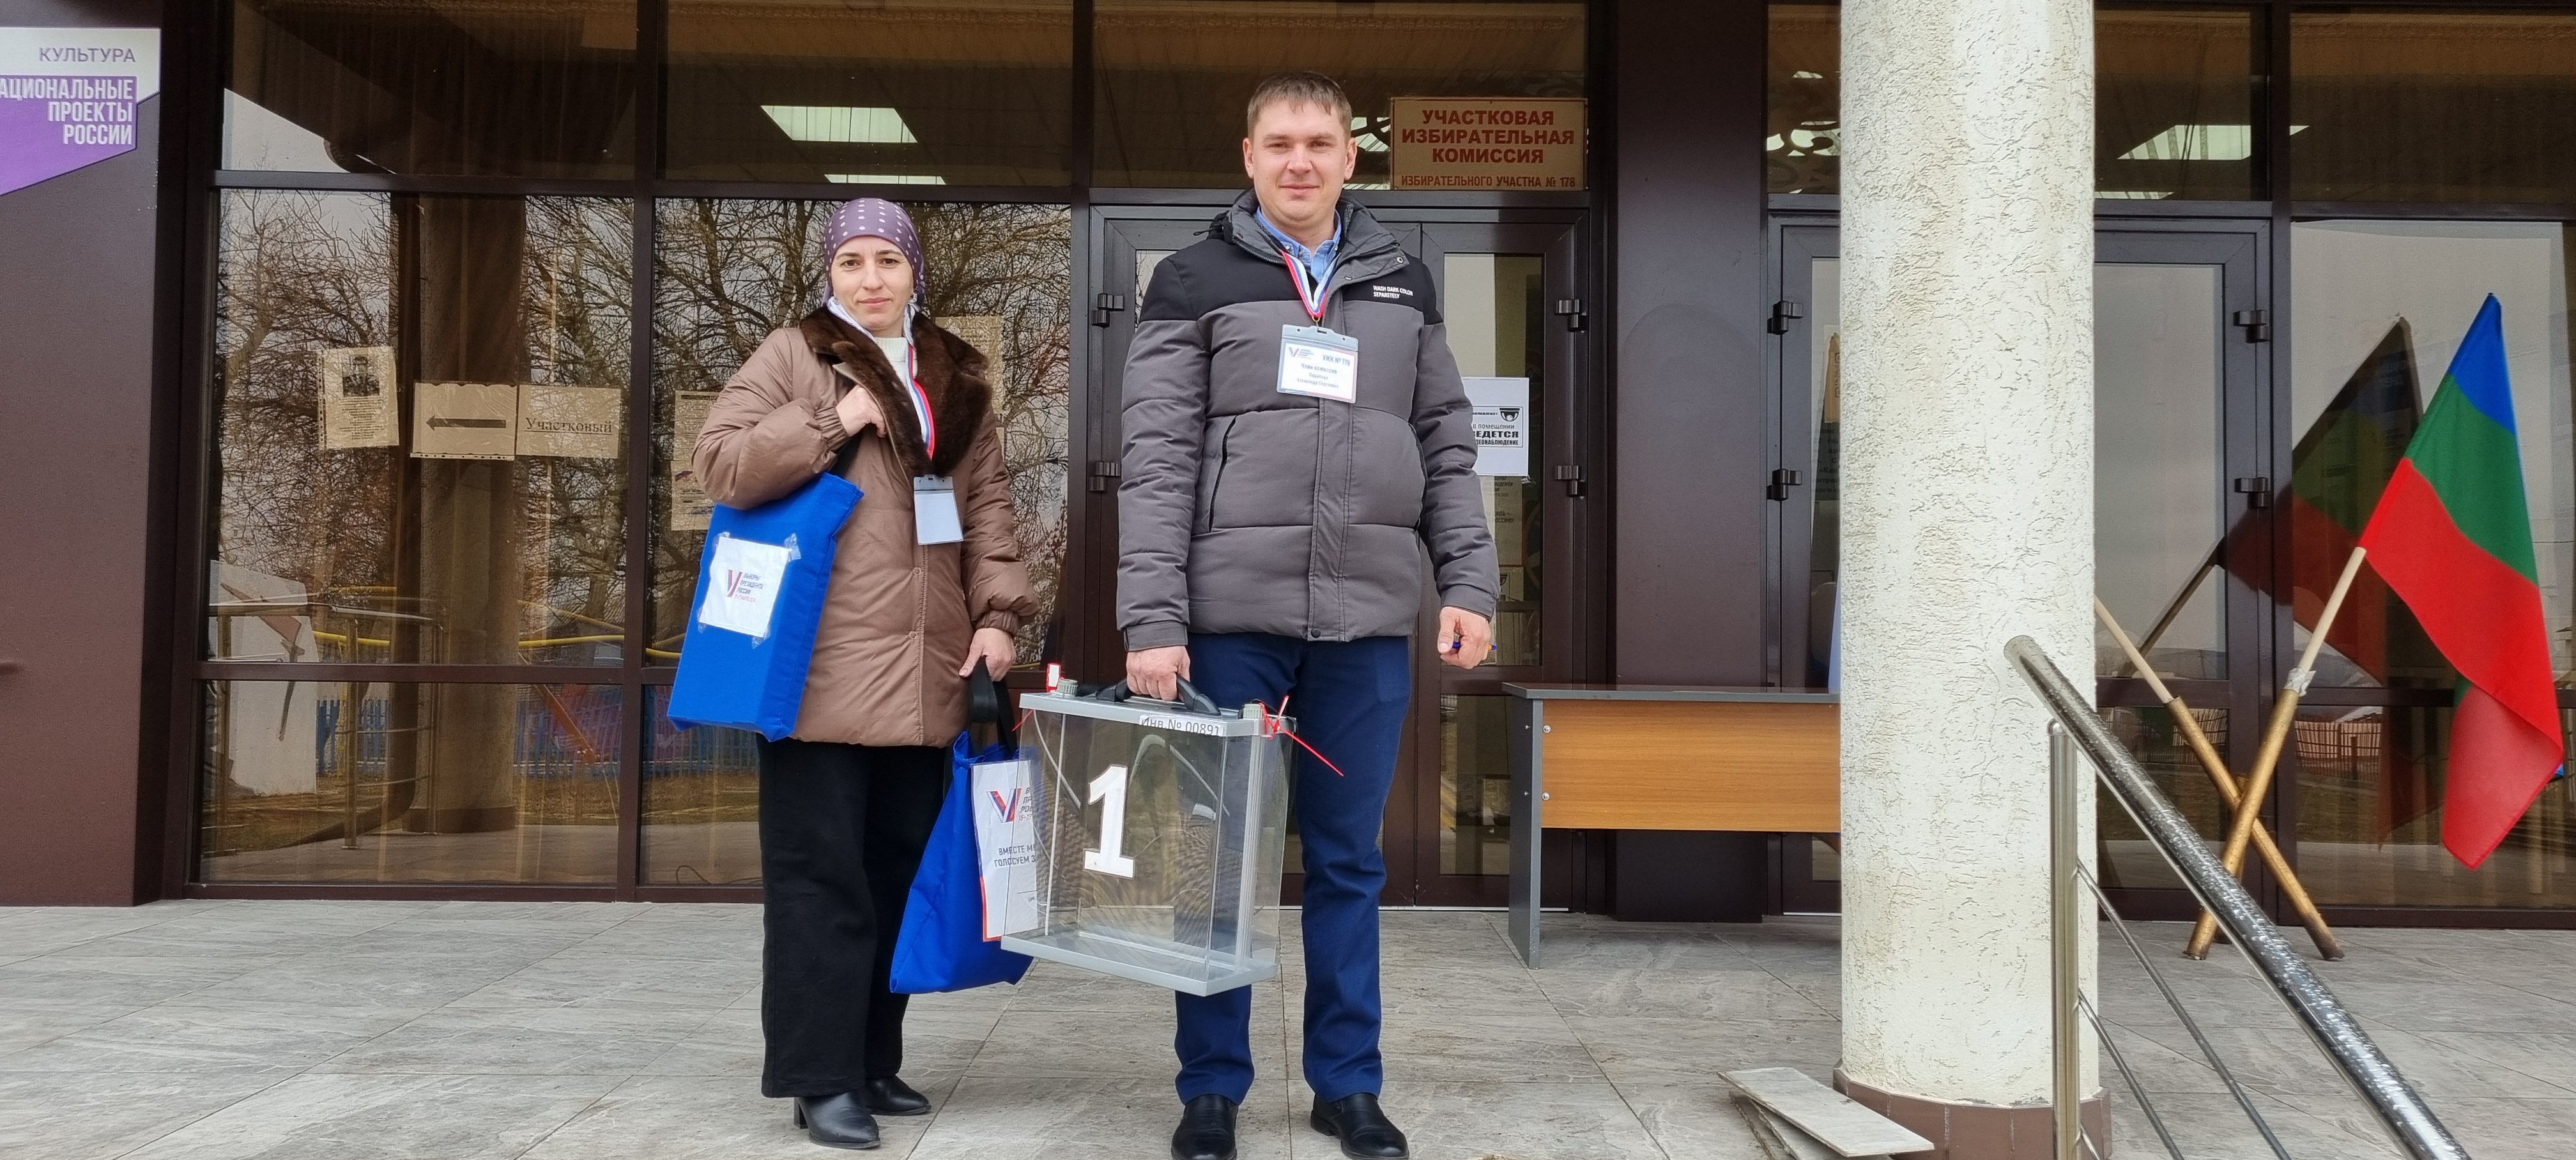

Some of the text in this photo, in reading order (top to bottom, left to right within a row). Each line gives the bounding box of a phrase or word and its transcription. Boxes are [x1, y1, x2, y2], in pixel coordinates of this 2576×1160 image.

[39, 47, 136, 63] КУЛЬТУРА
[0, 78, 134, 101] АЦИОНАЛЬНЫЕ
[48, 102, 132, 121] ПРОЕКТЫ
[1422, 110, 1554, 125] УЧАСТКОВАЯ
[63, 125, 132, 144] РОССИИ
[1402, 128, 1575, 144] ИЗБИРАТЕЛЬНАЯ
[1432, 148, 1544, 164] КОМИССИЯ
[1401, 175, 1575, 187] ИЗБИРАТЕЛЬНОГО УЧАСТКА № 178
[526, 417, 612, 432] Участковый
[1186, 721, 1219, 736] 00891
[1084, 765, 1135, 878] 1
[999, 844, 1025, 856] ВМЕСТЕ
[994, 856, 1030, 867] ГОЛОСУЕМ
